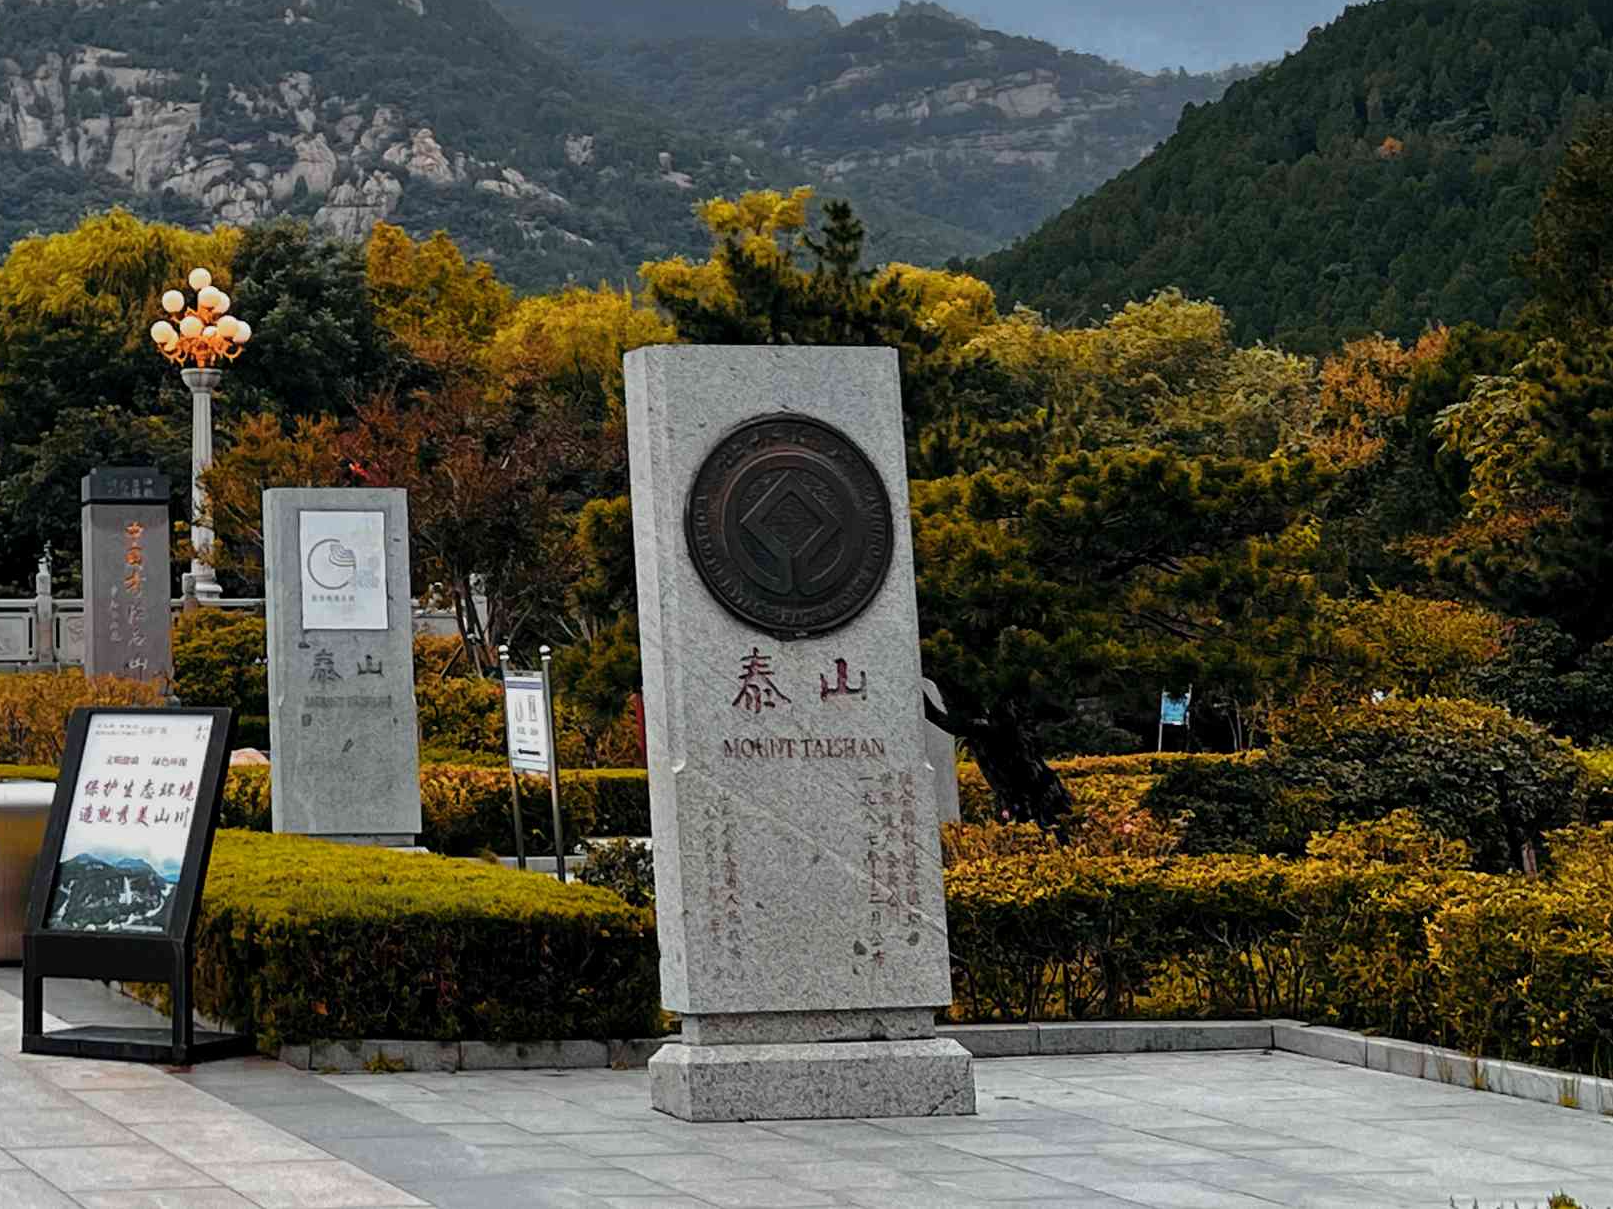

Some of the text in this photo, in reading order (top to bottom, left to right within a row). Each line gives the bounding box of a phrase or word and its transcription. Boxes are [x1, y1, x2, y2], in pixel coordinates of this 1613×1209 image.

[731, 646, 868, 714] 泰山
[723, 737, 886, 760] MOUNT TAISHAN
[84, 778, 196, 802] 保护生态环境
